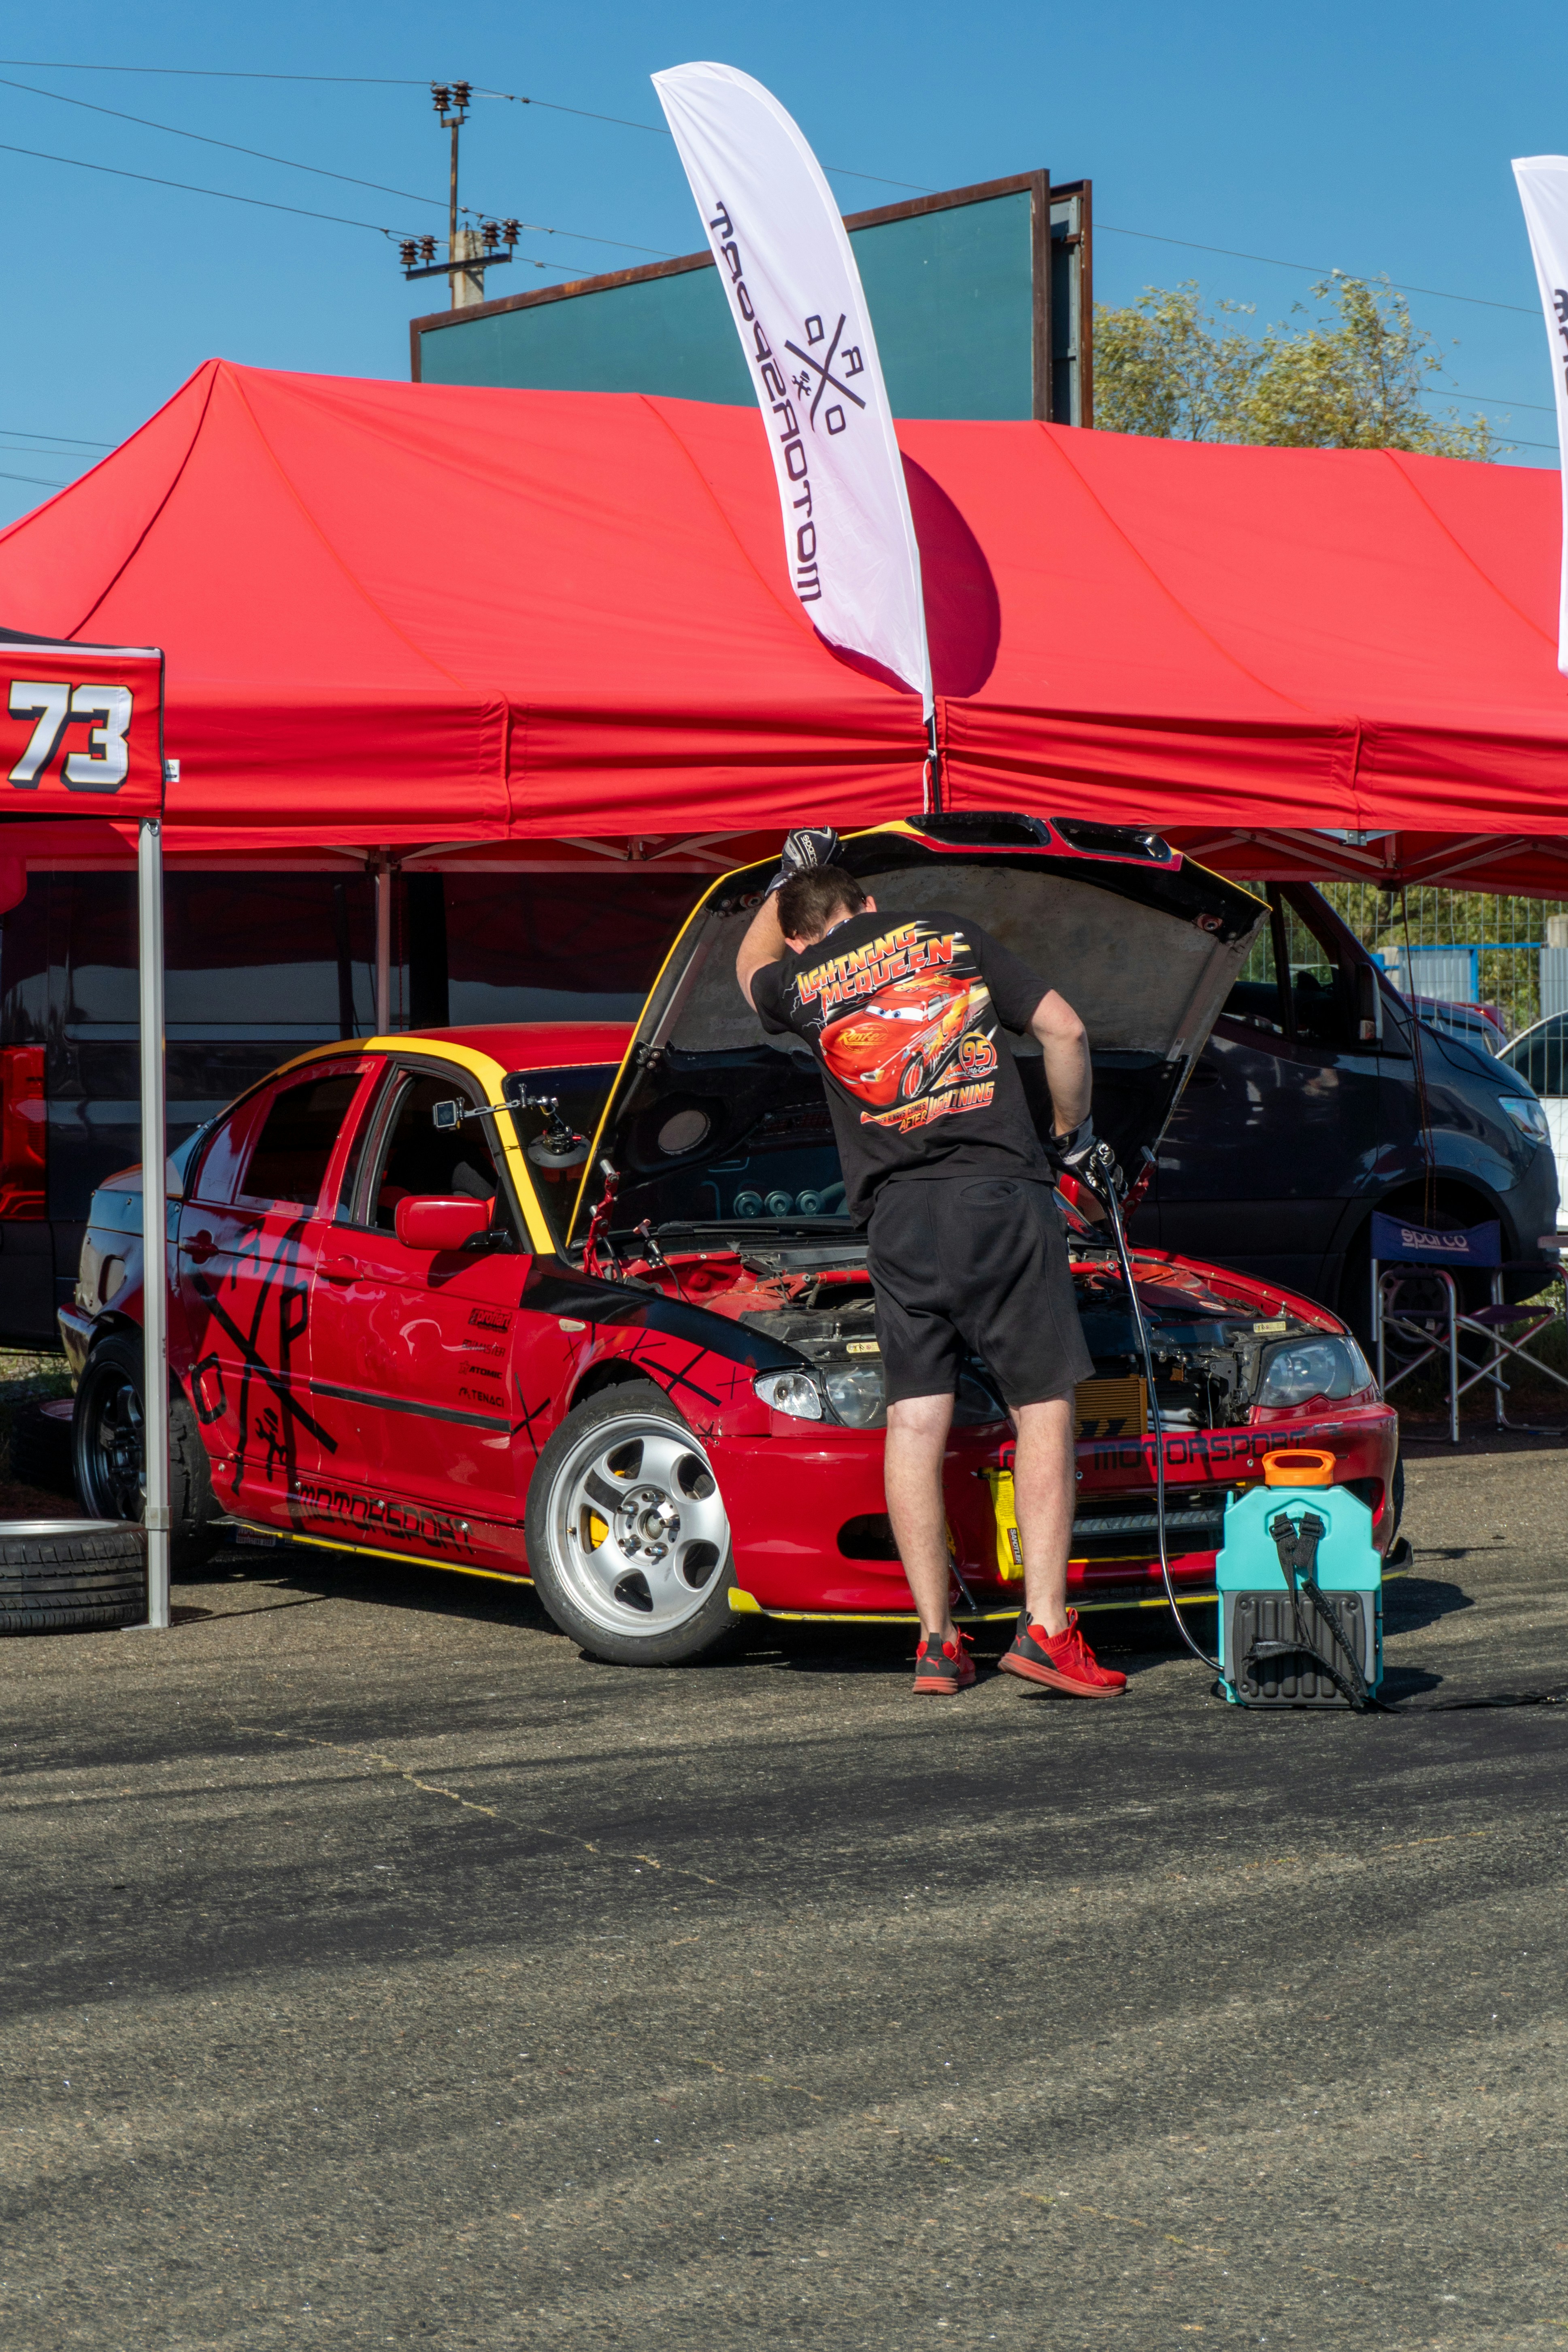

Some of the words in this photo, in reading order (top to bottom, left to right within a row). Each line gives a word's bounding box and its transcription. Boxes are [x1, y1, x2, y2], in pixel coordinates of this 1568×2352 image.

[7, 679, 134, 794] 73
[796, 922, 917, 1005] LIGHTNING
[963, 1040, 991, 1068] 95
[898, 1109, 928, 1131] AFTER
[926, 1081, 995, 1124] LIGHTNING
[1401, 1229, 1467, 1249] sparco
[468, 1365, 503, 1379] ATOMIC
[471, 1389, 505, 1408] TENACI
[1094, 1431, 1306, 1470] MOTORSPORT
[300, 1484, 473, 1555] MOTORSPORT
[1010, 1529, 1022, 1564] SANDTLER
